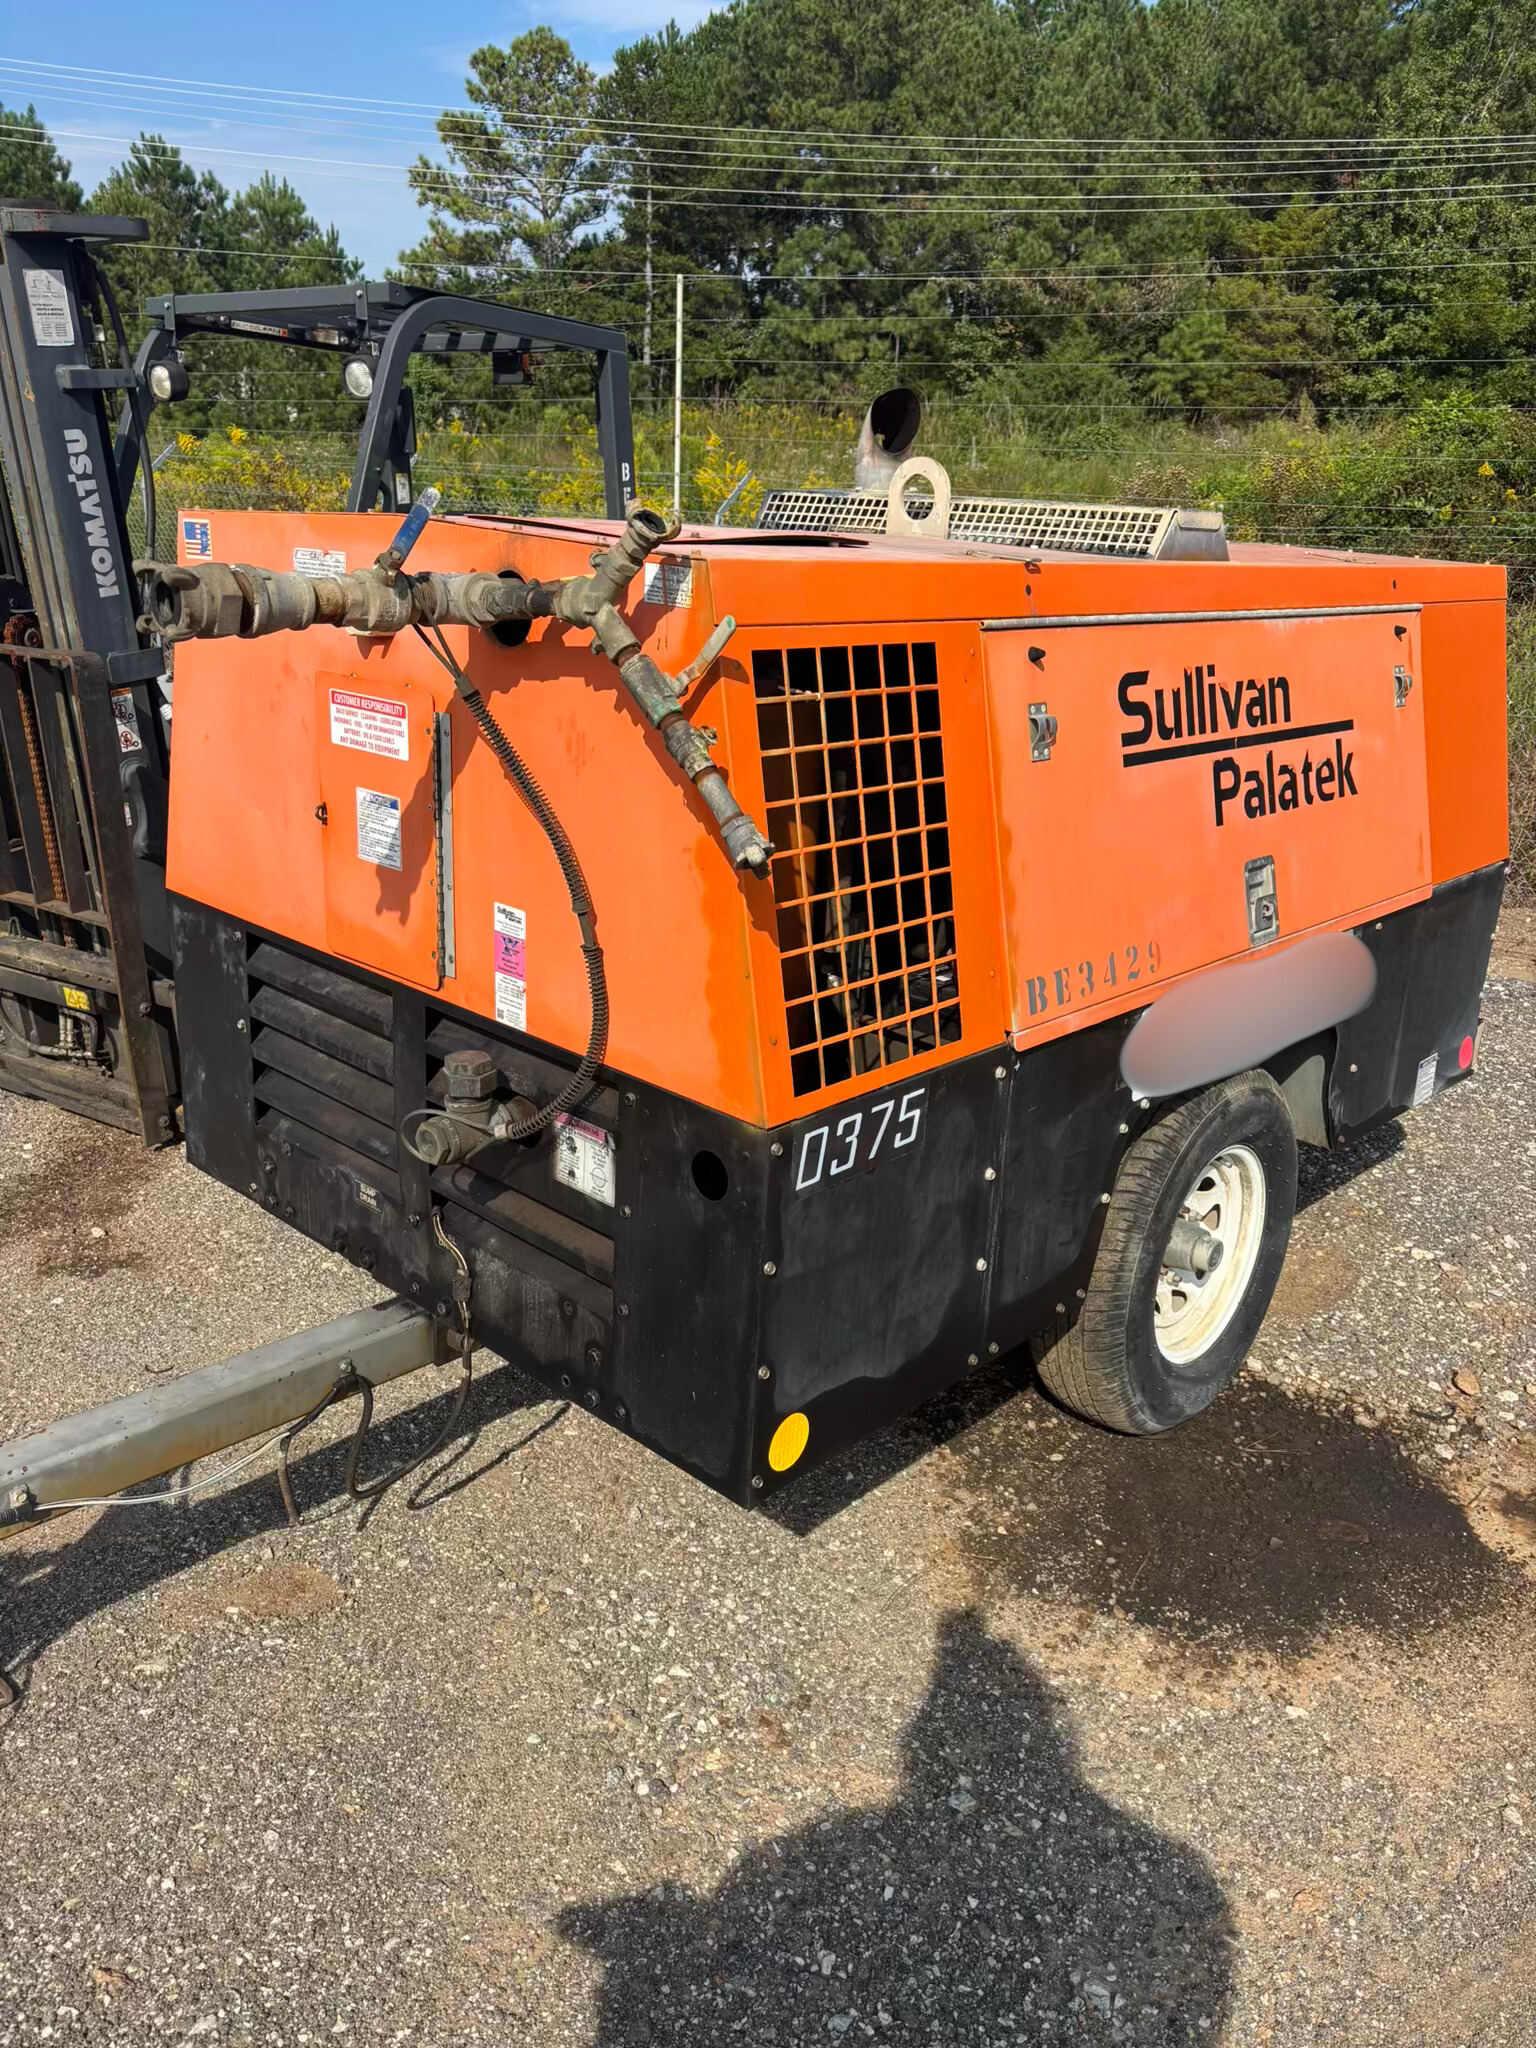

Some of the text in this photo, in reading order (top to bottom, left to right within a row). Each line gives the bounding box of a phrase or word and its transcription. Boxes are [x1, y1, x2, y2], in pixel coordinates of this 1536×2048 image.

[63, 428, 120, 598] KOMATSU
[334, 693, 402, 716] CUSTOMER RESPONSIBILITY
[1117, 664, 1292, 748] Sullivan
[349, 738, 367, 748] DAMAGE
[375, 743, 400, 756] EQUIPMENT
[1212, 738, 1358, 827] Palatek
[1025, 939, 1161, 1016] BE3429
[795, 1087, 926, 1192] 0375
[360, 1183, 377, 1198] SUMP
[360, 1192, 377, 1207] DRAIN
